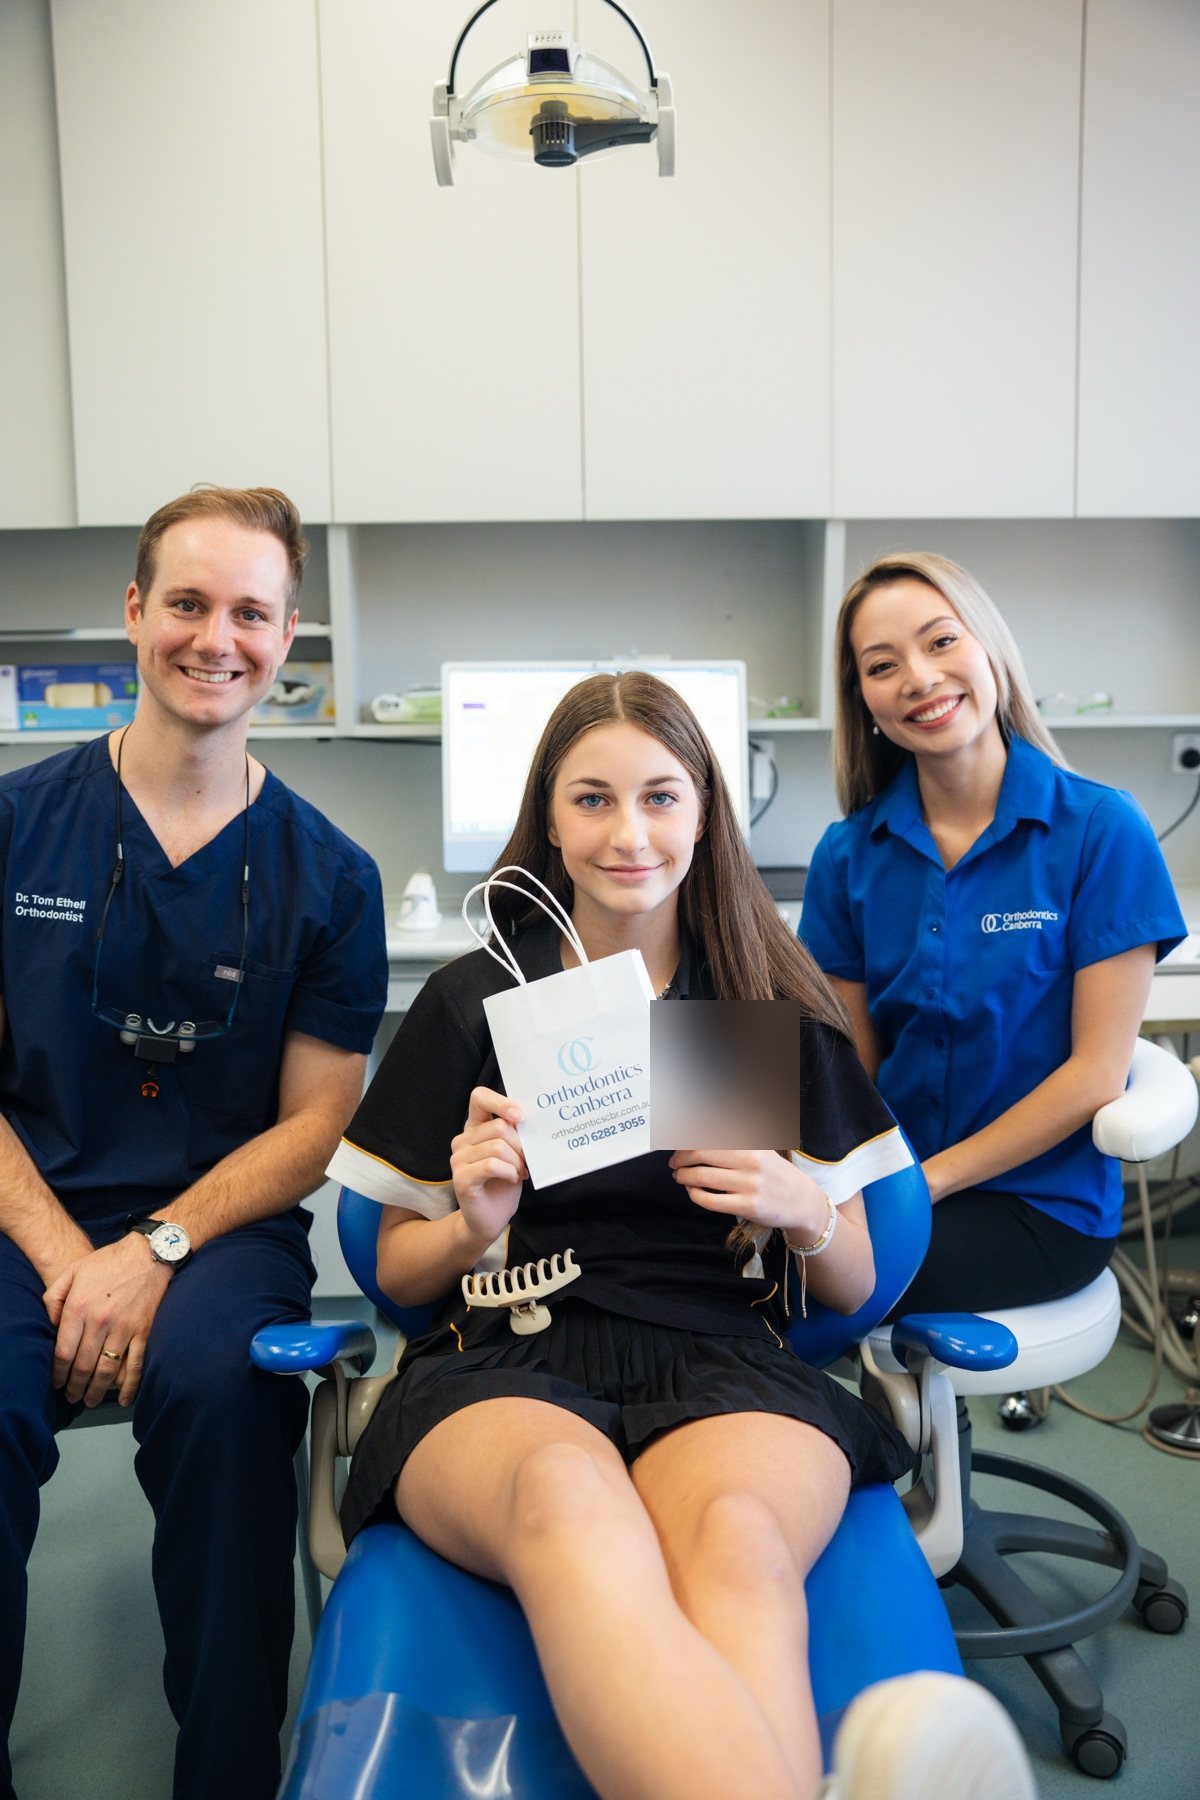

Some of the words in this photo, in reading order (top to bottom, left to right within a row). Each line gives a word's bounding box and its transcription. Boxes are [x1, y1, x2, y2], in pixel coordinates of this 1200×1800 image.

[15, 892, 29, 903] Dr.
[31, 894, 54, 906] Tom
[56, 897, 86, 909] Ethell
[15, 905, 83, 923] Orthodontist
[1002, 909, 1058, 922] Orthodontics
[1002, 920, 1042, 931] Canberra
[536, 1063, 643, 1109] Orthodontics
[558, 1087, 633, 1121] Canberra
[567, 1133, 590, 1151] (02)
[591, 1125, 618, 1142] 6282
[619, 1115, 646, 1132] 3055
